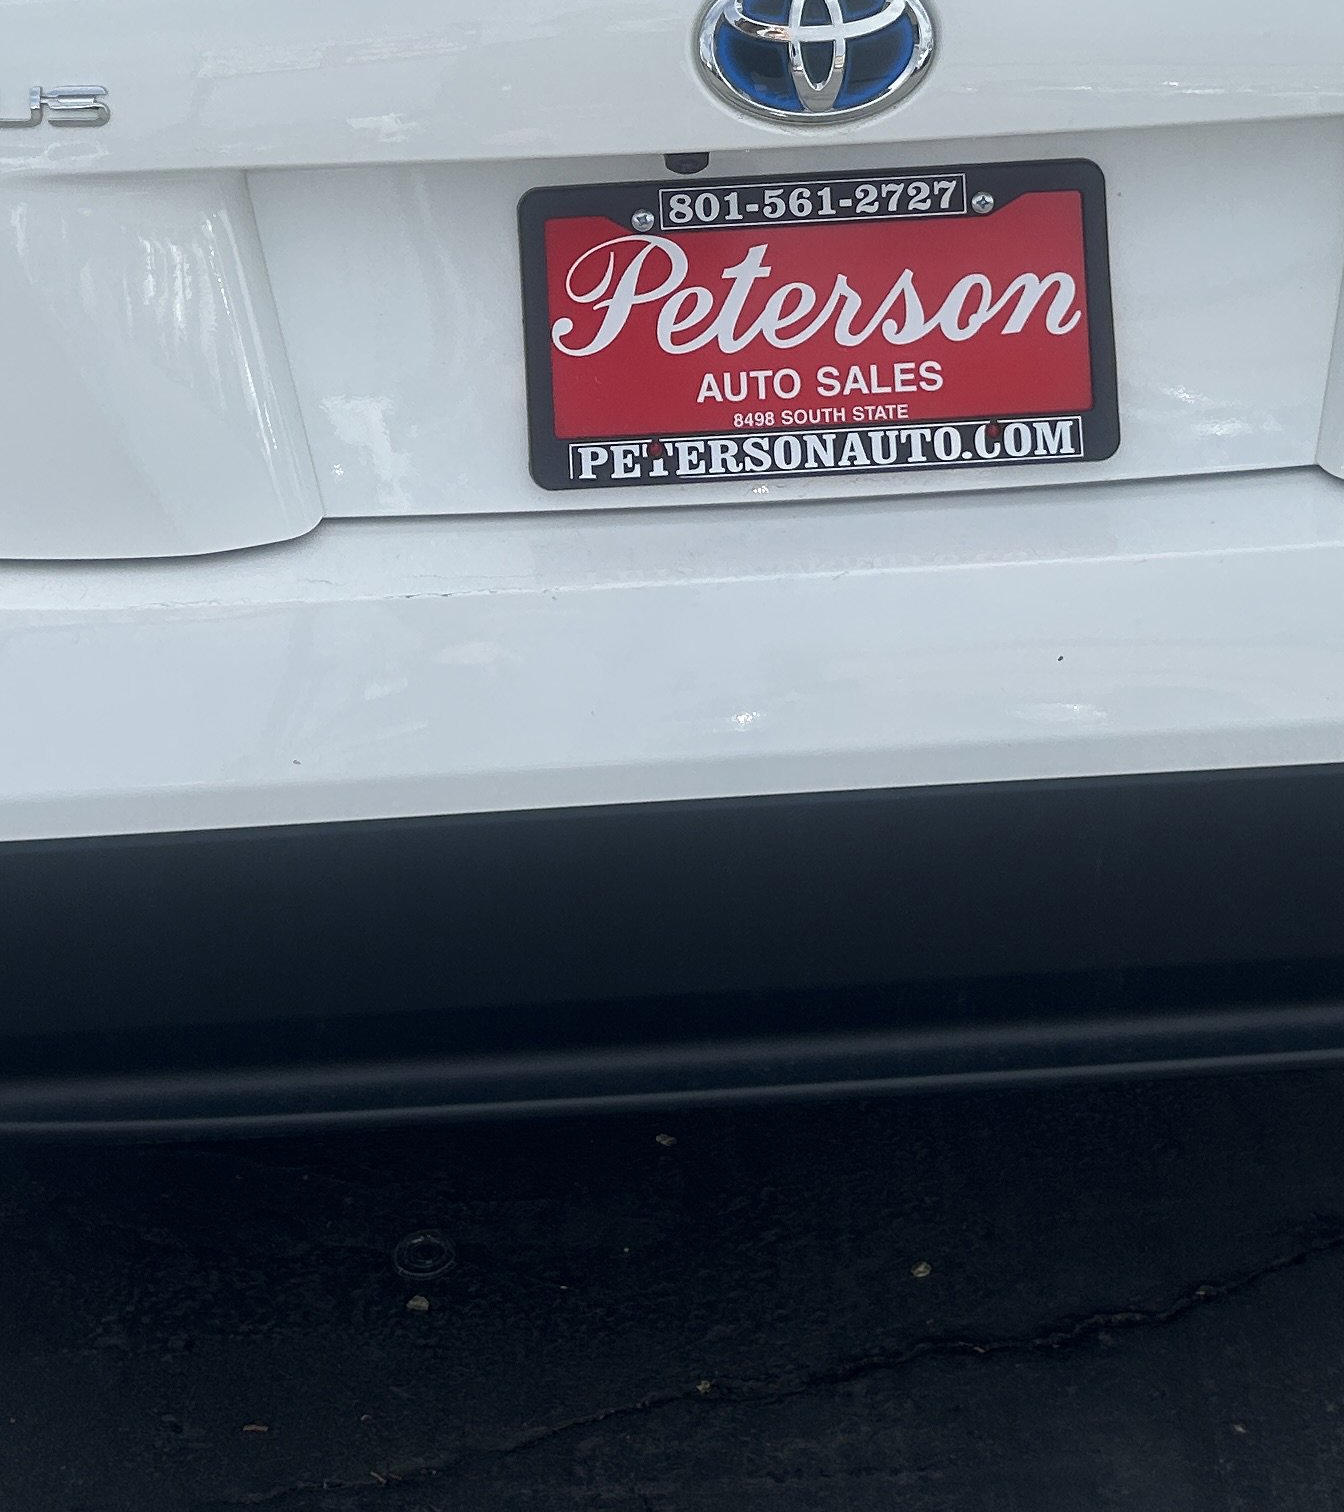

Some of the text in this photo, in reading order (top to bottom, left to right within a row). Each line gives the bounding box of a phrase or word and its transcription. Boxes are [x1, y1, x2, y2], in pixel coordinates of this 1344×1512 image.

[668, 179, 957, 224] 801-561-2727
[551, 235, 1082, 356] Peterson
[697, 360, 944, 403] AUTO SALES
[732, 404, 910, 428] 8498 SOUTH STATE
[578, 421, 1076, 481] PETERSONAUTO.COM
